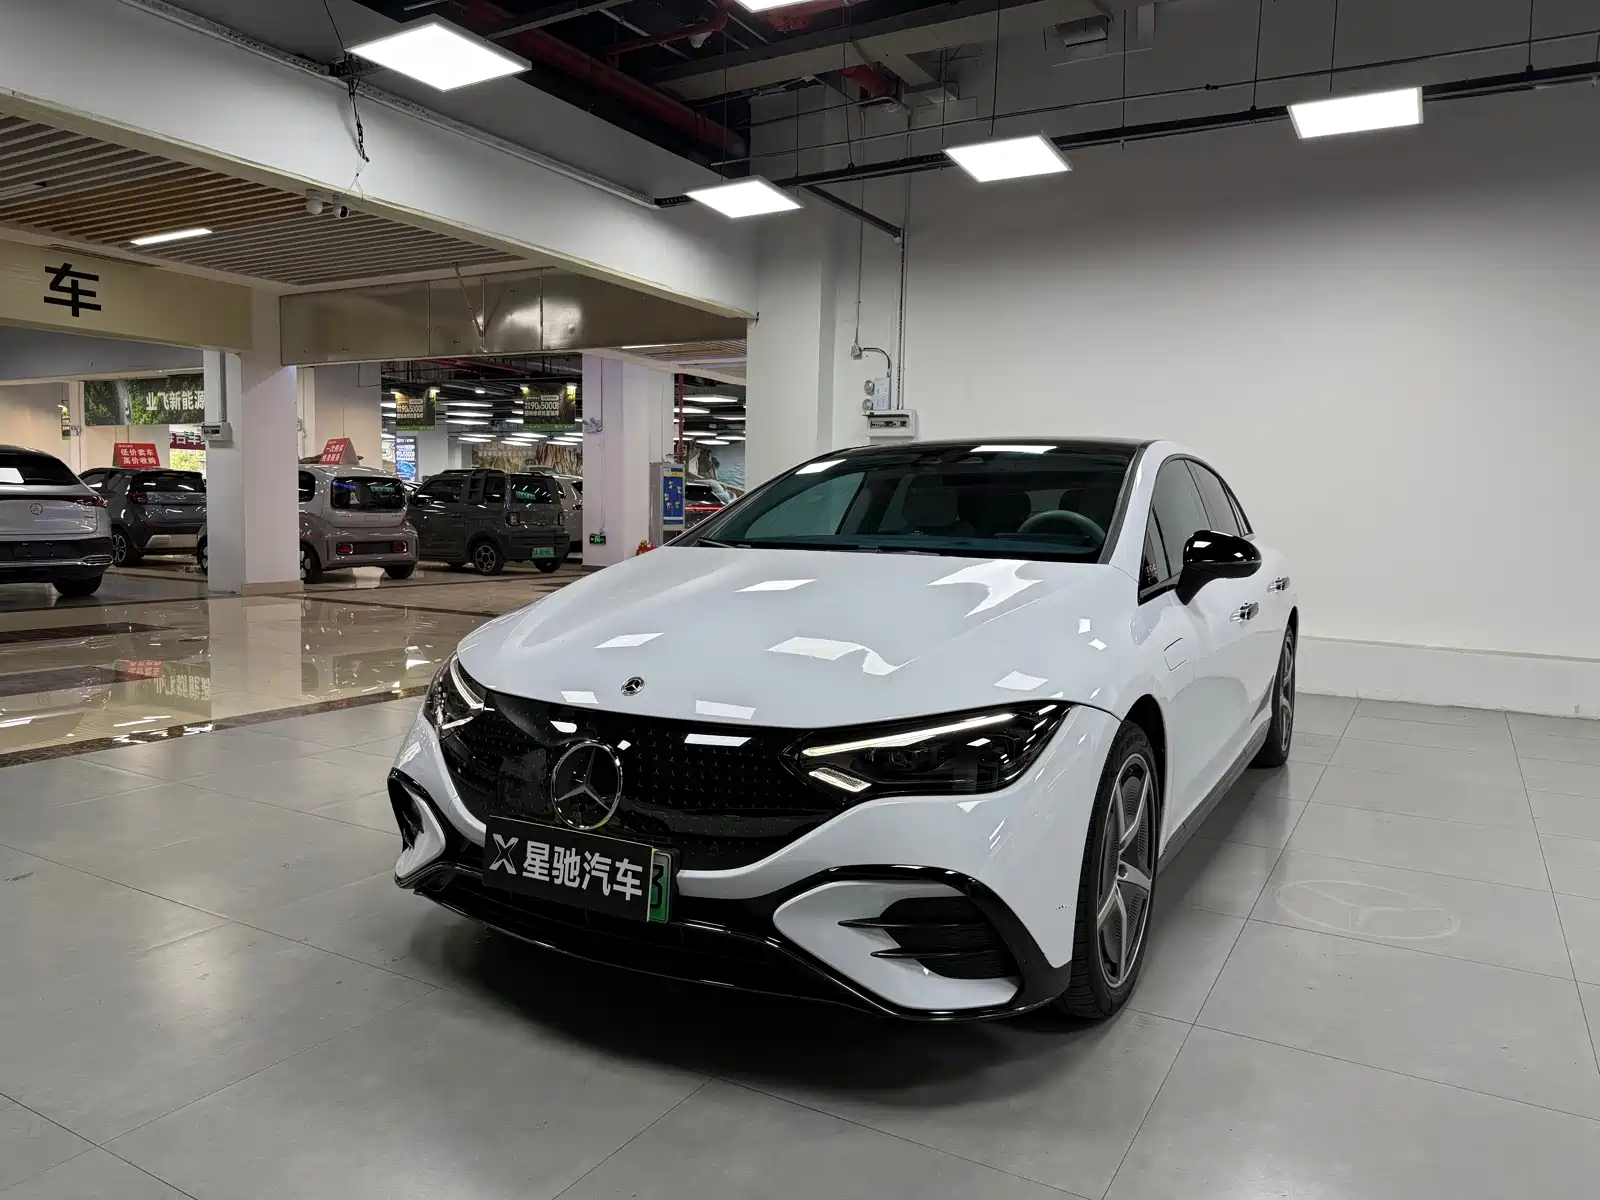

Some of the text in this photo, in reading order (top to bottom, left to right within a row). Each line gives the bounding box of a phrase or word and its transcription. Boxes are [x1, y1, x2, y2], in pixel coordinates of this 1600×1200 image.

[43, 262, 102, 317] 车
[522, 840, 643, 901] 星驰汽车
